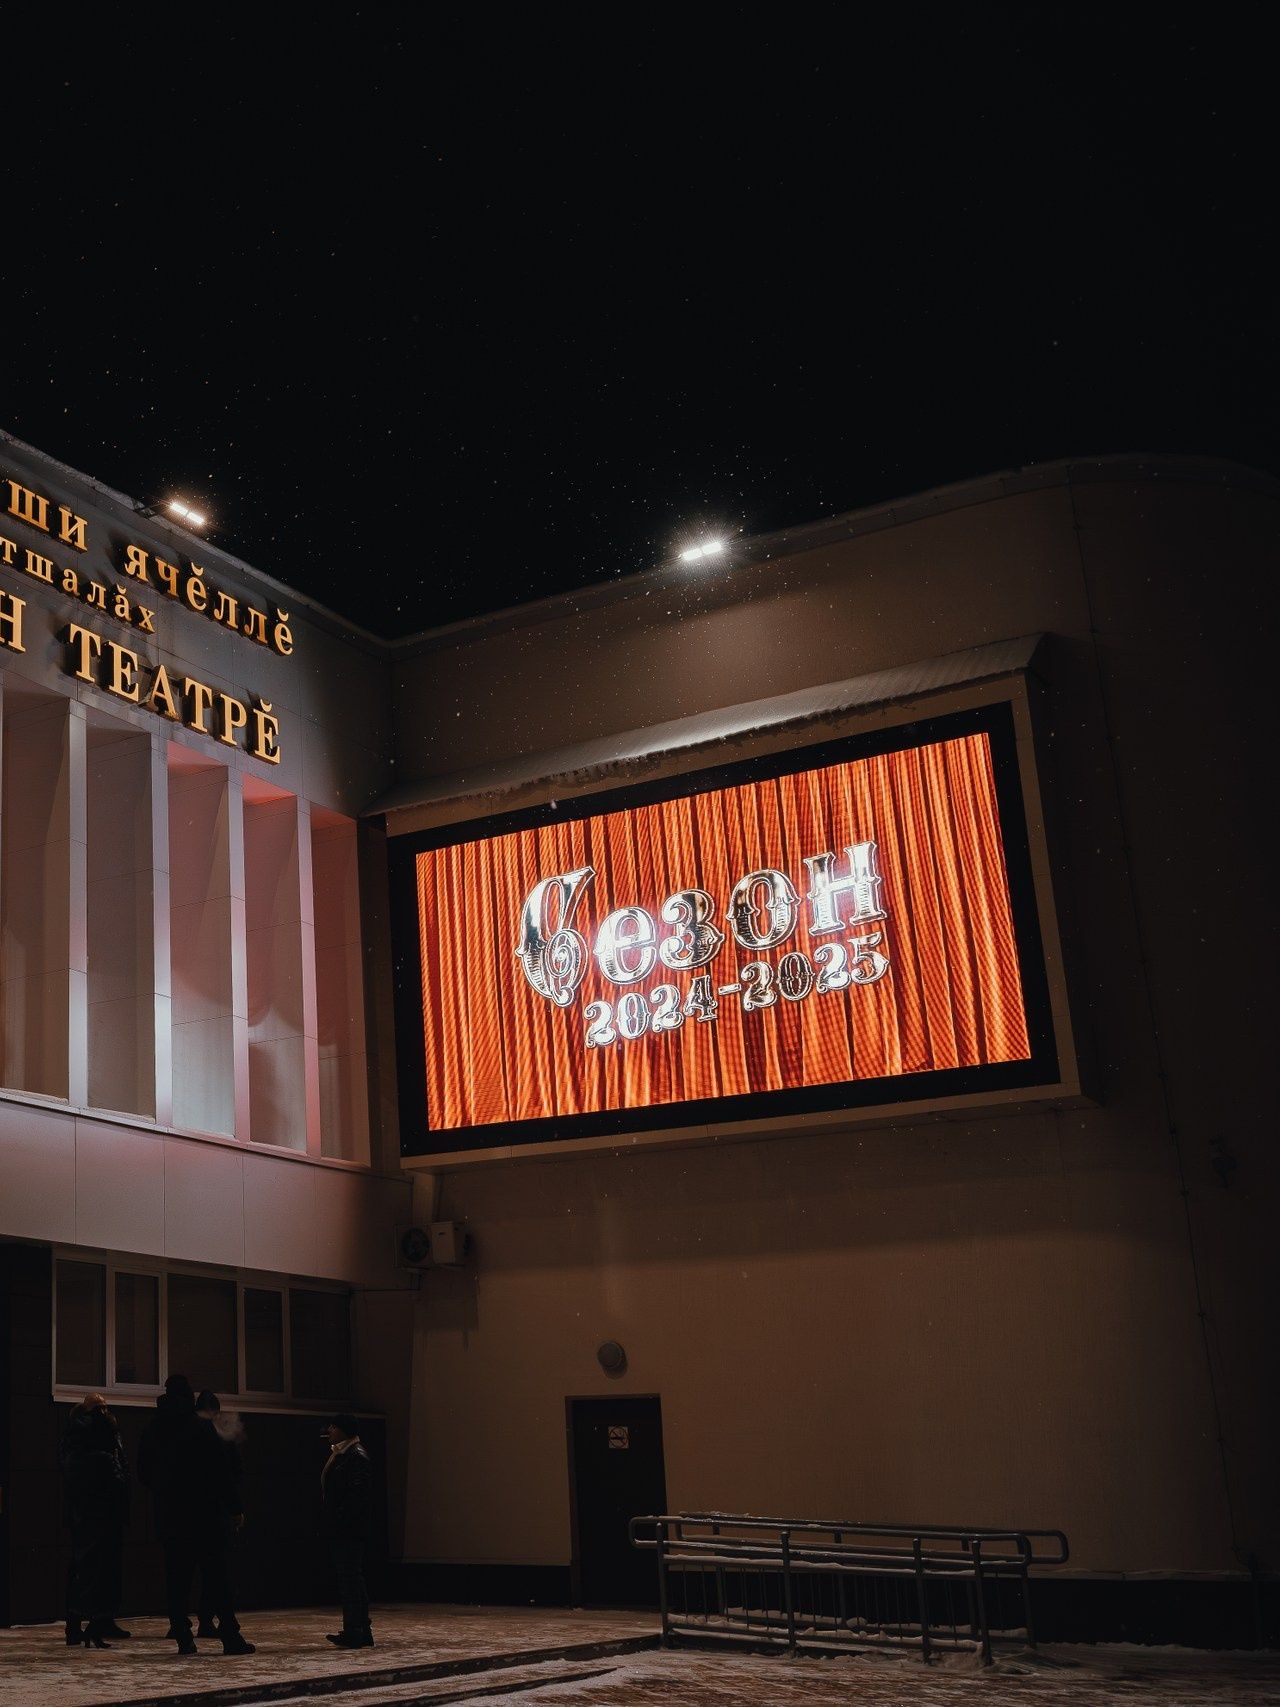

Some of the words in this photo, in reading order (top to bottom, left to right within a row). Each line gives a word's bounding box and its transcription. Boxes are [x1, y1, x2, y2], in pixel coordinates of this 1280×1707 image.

[125, 543, 294, 657] ячӗллӗ
[69, 623, 282, 764] ТЕАТРӖ
[515, 840, 888, 1008] Сезон
[584, 932, 890, 1049] 2024-2025
